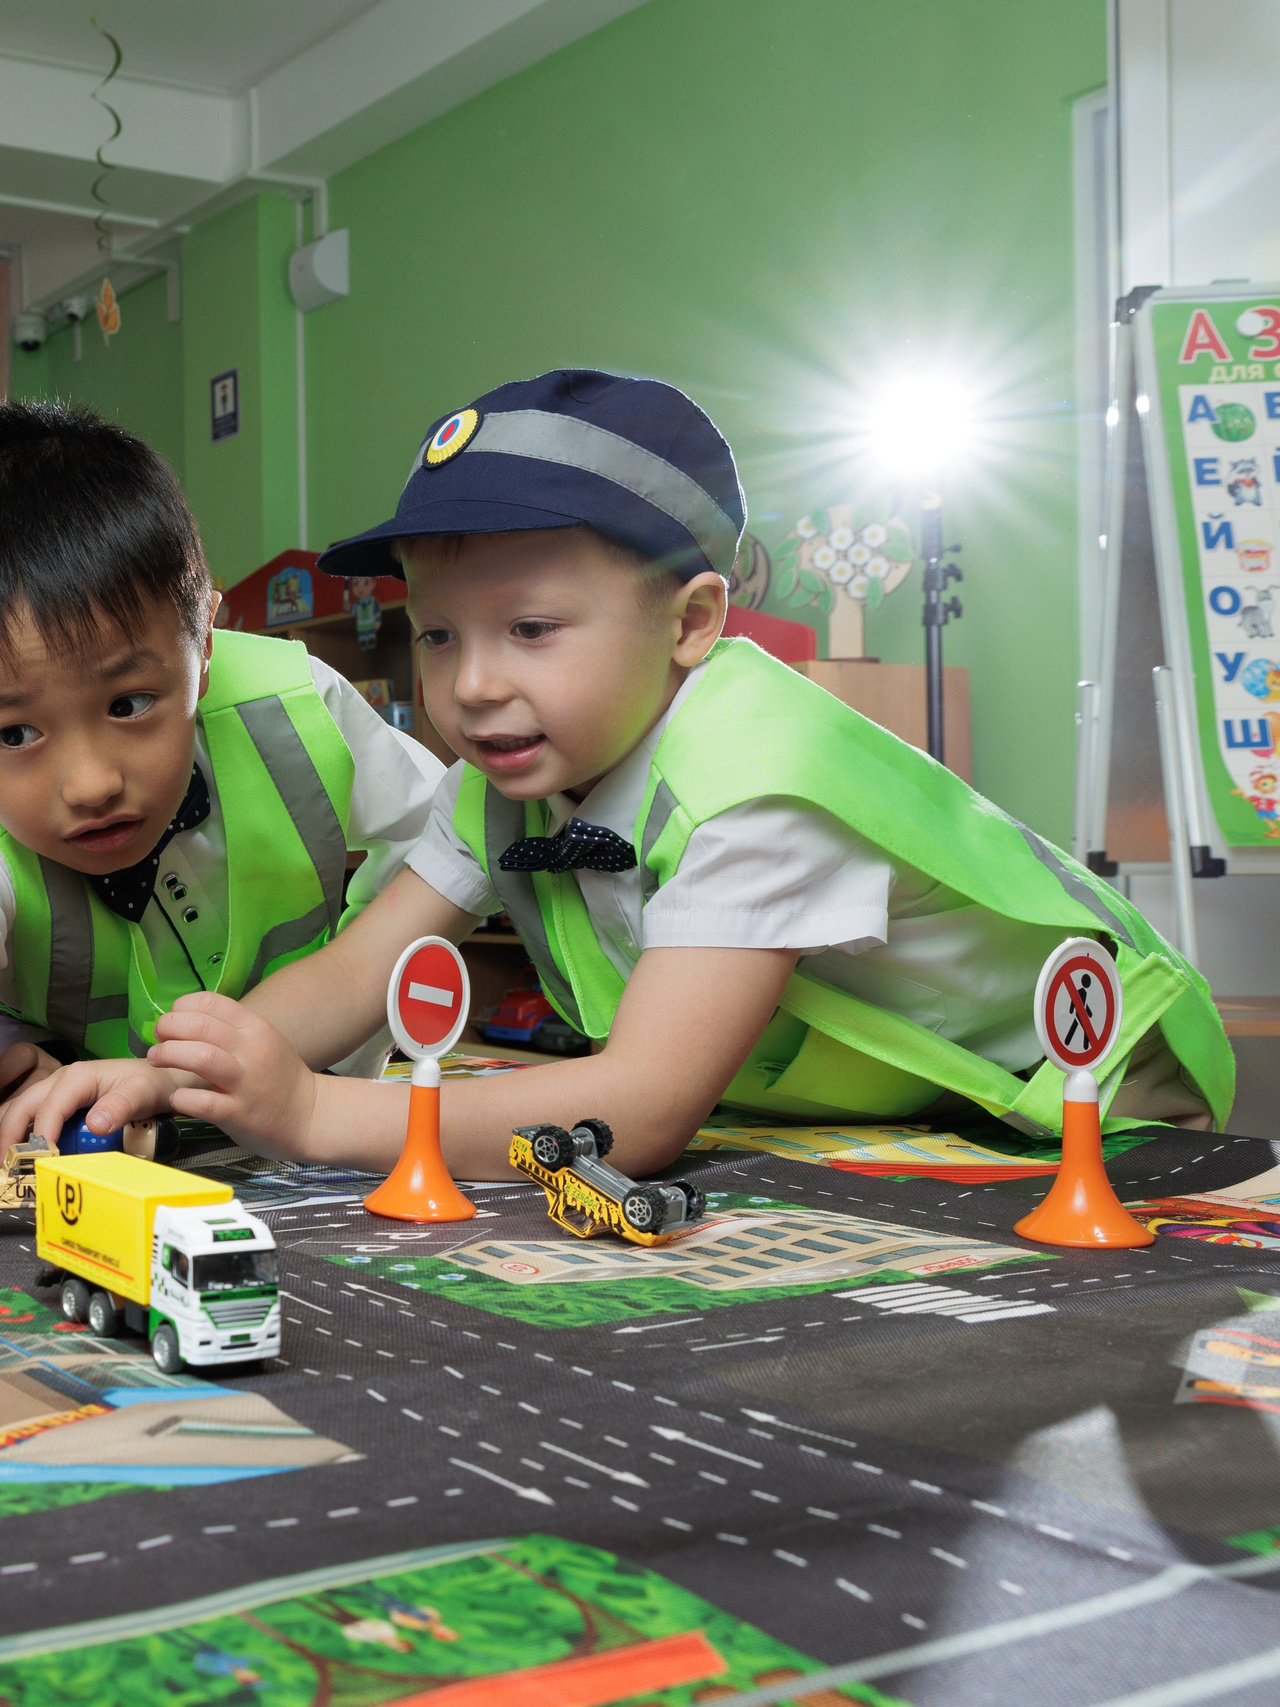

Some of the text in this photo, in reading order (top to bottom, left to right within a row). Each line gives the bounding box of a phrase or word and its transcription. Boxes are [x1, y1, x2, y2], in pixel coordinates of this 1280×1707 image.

[1208, 364, 1266, 384] для
[1193, 457, 1221, 486] Е
[1202, 512, 1236, 550] Й
[1209, 585, 1242, 616] О
[1214, 652, 1246, 683] У
[1223, 718, 1272, 749] Ш
